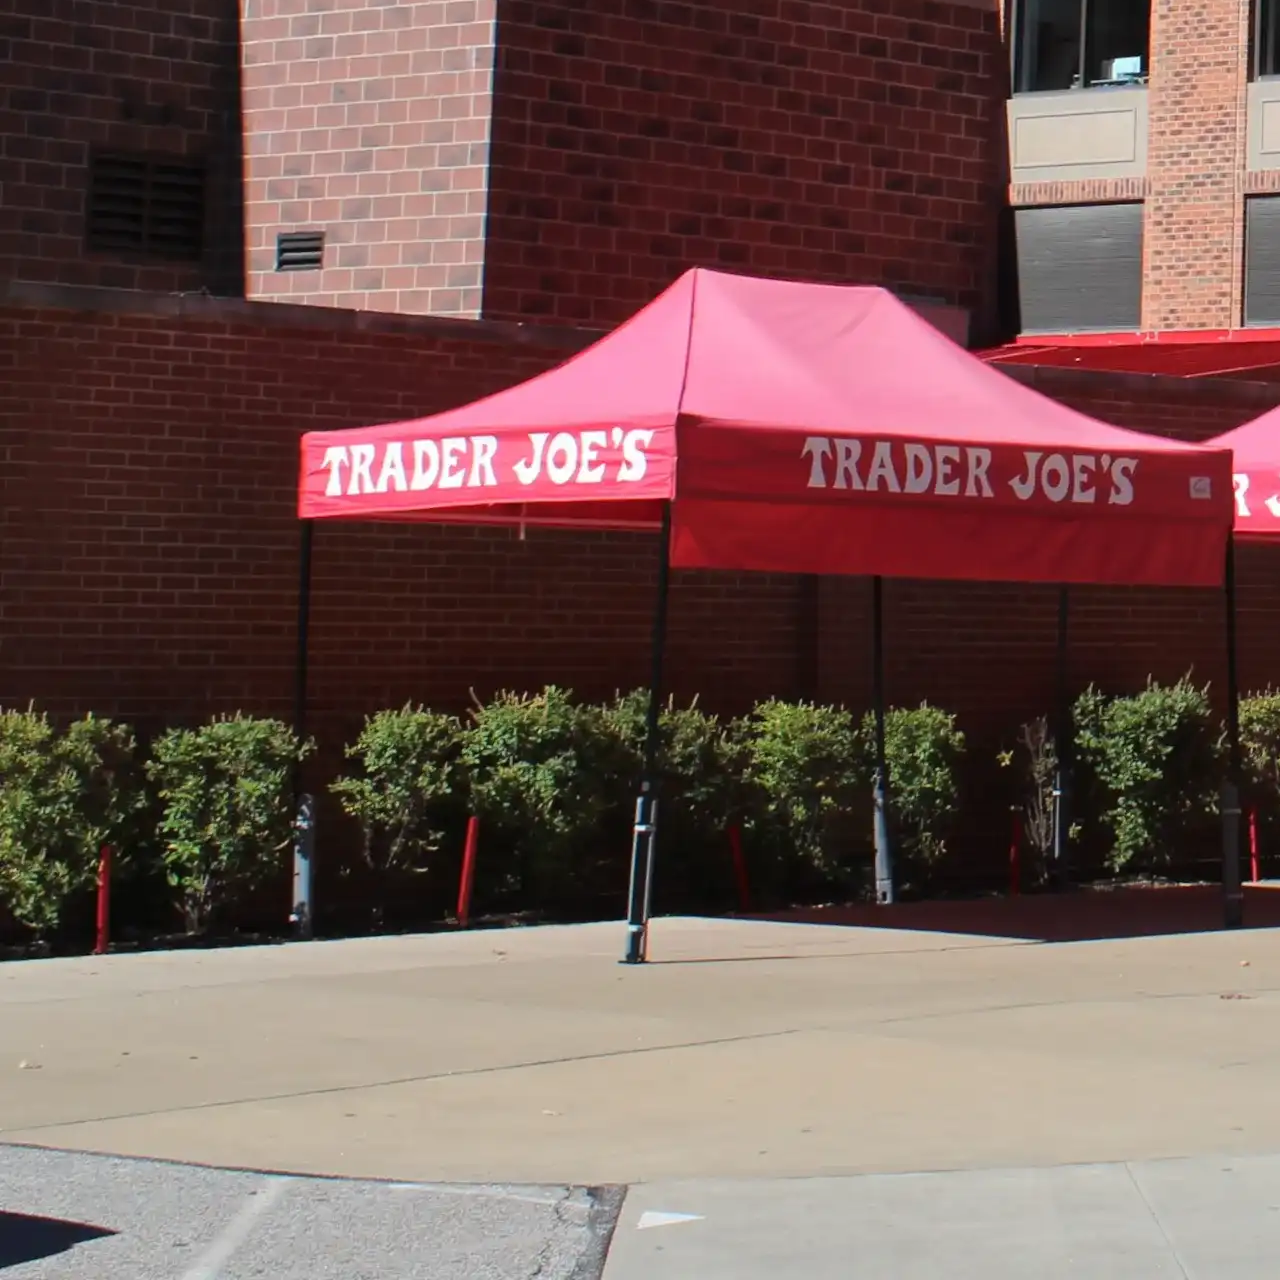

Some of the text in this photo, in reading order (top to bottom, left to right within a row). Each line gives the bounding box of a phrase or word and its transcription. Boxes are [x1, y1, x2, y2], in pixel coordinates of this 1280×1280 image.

[322, 426, 654, 498] TRADER JOE'S
[801, 437, 1139, 506] TRADER JOE'S
